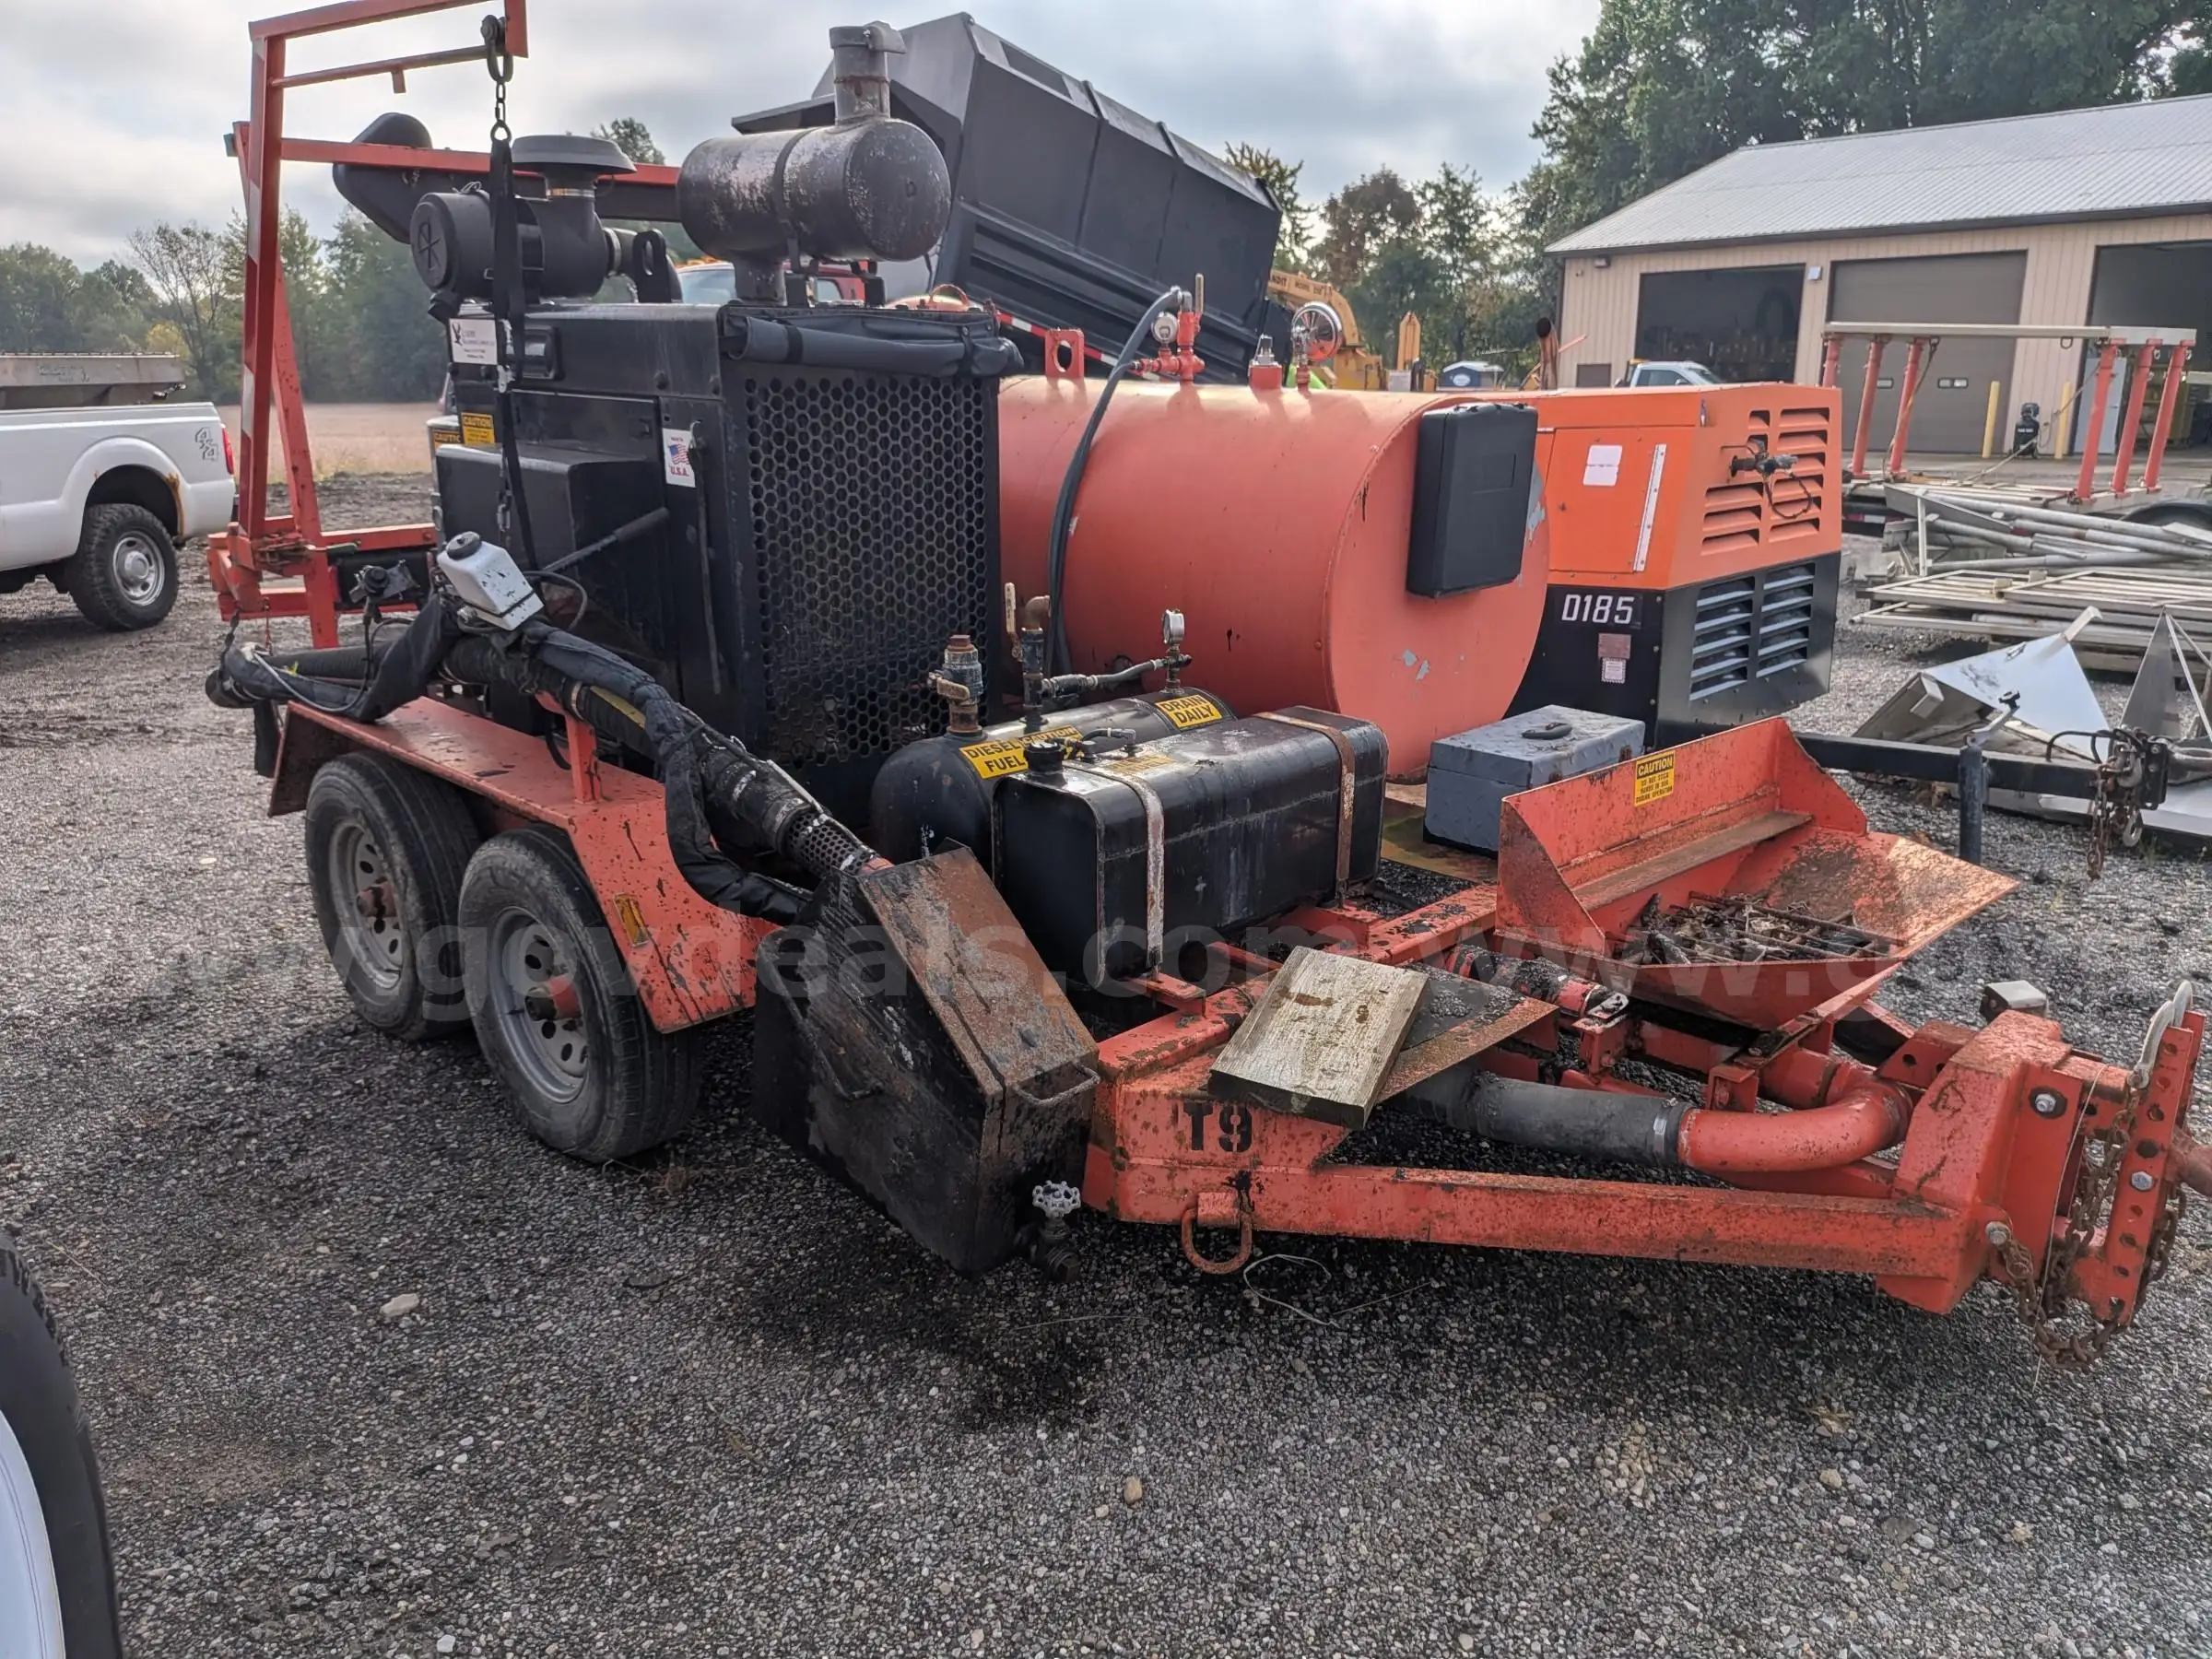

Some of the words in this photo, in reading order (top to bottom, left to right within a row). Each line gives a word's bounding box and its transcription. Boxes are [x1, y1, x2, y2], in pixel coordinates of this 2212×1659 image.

[1161, 696, 1206, 712] DRAIN
[1173, 705, 1215, 724] DAILY
[1020, 727, 1077, 745] CAUTION
[965, 740, 1021, 759] DIESEL
[984, 755, 1026, 772] FUEL
[1638, 756, 1673, 776] CAUTION
[1182, 1100, 1253, 1153] T9
